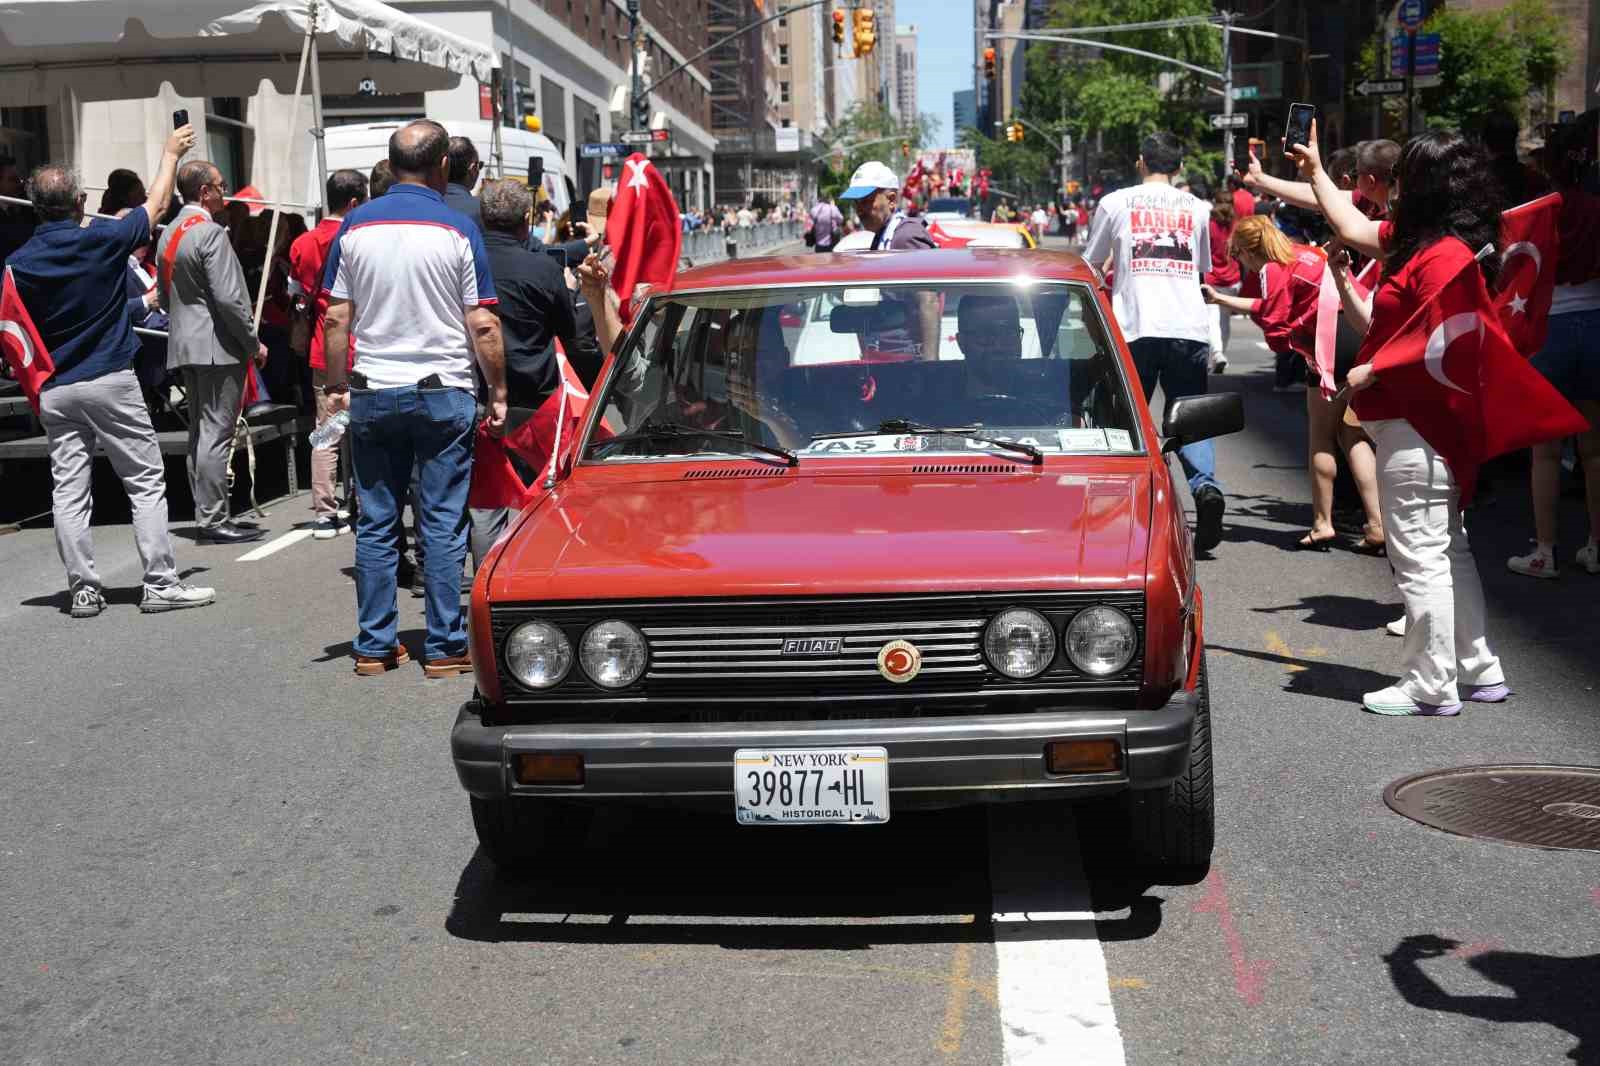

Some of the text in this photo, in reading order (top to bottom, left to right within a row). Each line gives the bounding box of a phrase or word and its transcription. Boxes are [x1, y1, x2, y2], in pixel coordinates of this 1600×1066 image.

[1131, 210, 1193, 230] KANGAL
[786, 639, 838, 652] FIAT
[773, 752, 848, 767] NEW YORK
[747, 769, 824, 806] 39877
[782, 809, 845, 818] HISTORICAL
